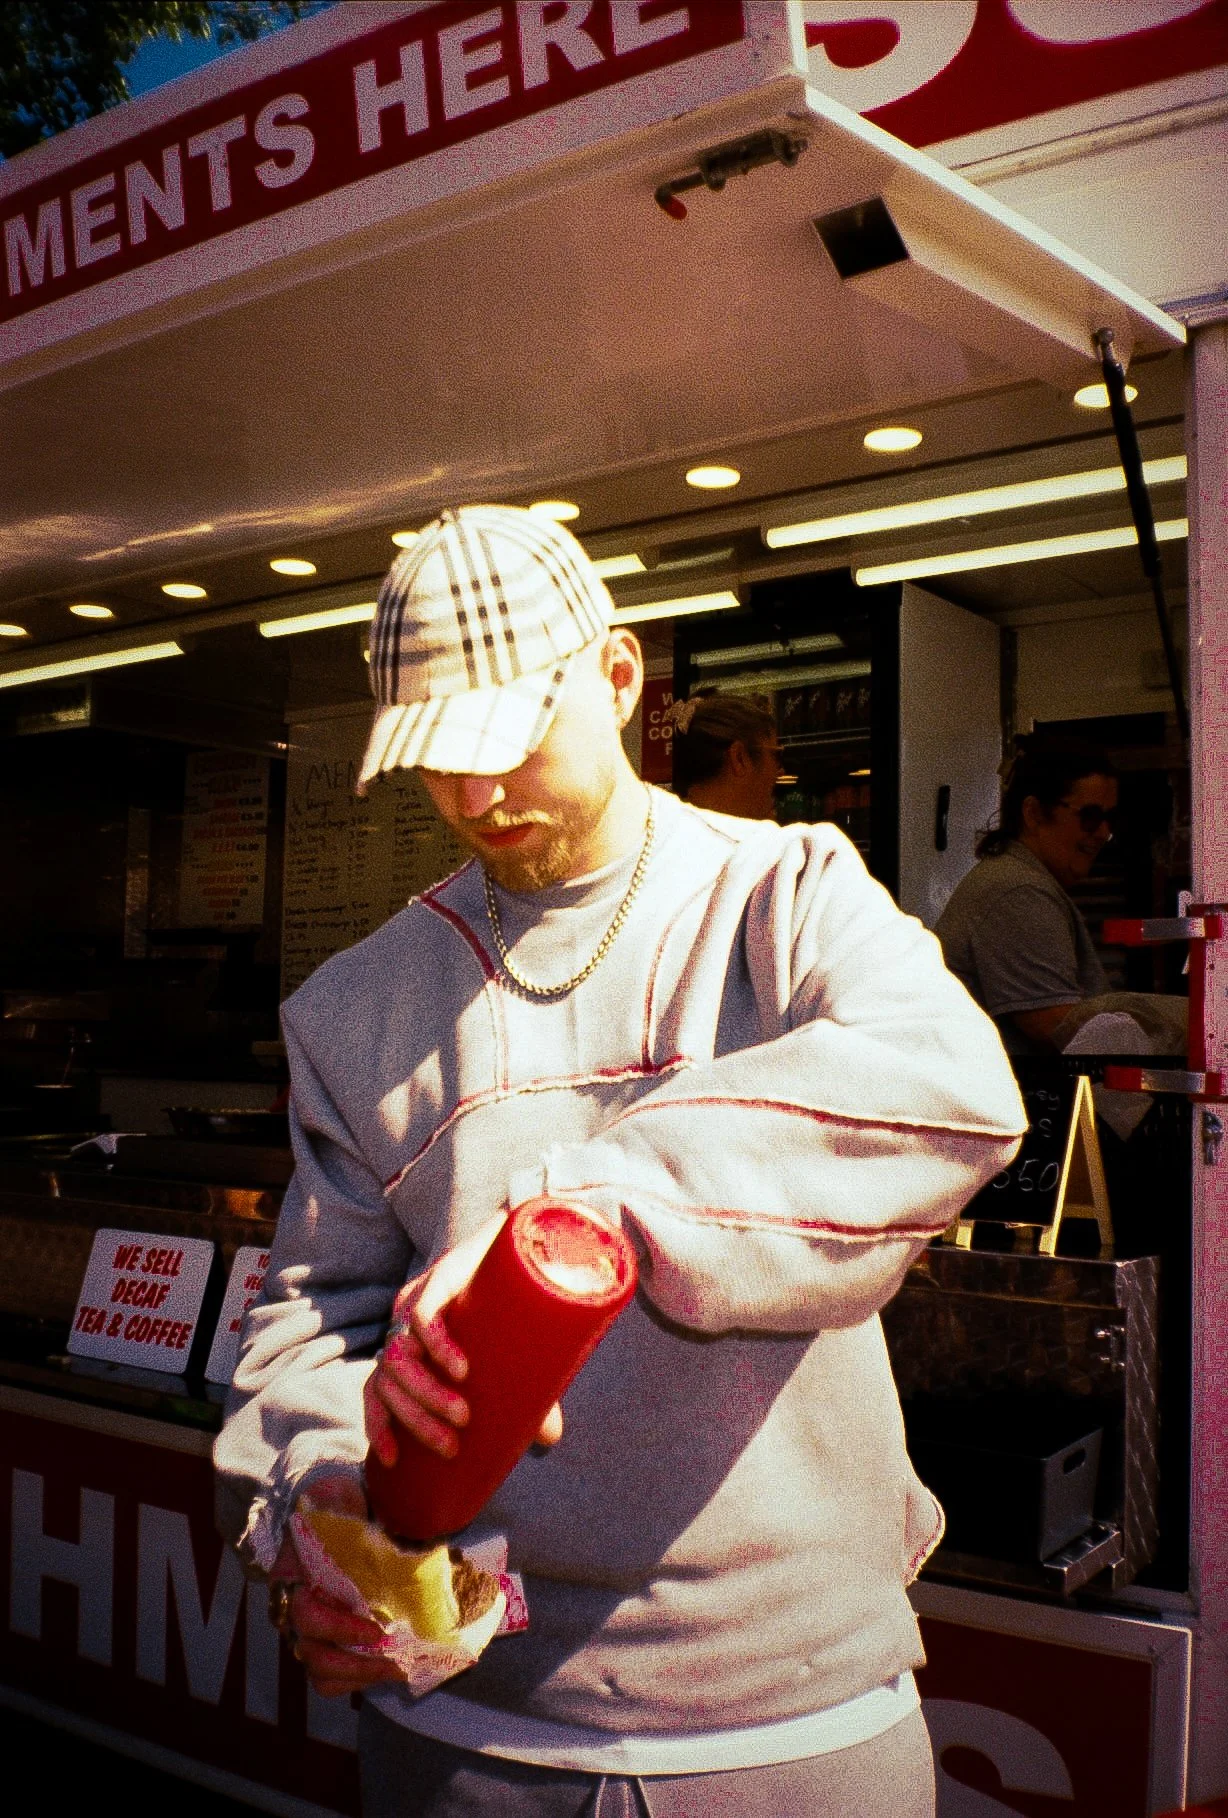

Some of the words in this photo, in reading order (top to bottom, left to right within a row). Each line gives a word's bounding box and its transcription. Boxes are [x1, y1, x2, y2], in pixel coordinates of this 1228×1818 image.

[3, 92, 316, 297] MENTS
[352, 0, 691, 155] HERE
[112, 1244, 143, 1271] WE
[142, 1248, 184, 1278] SELL
[111, 1278, 170, 1310] DECAF
[75, 1306, 107, 1335] TEA
[107, 1313, 124, 1337] &
[124, 1314, 193, 1350] COFFEE
